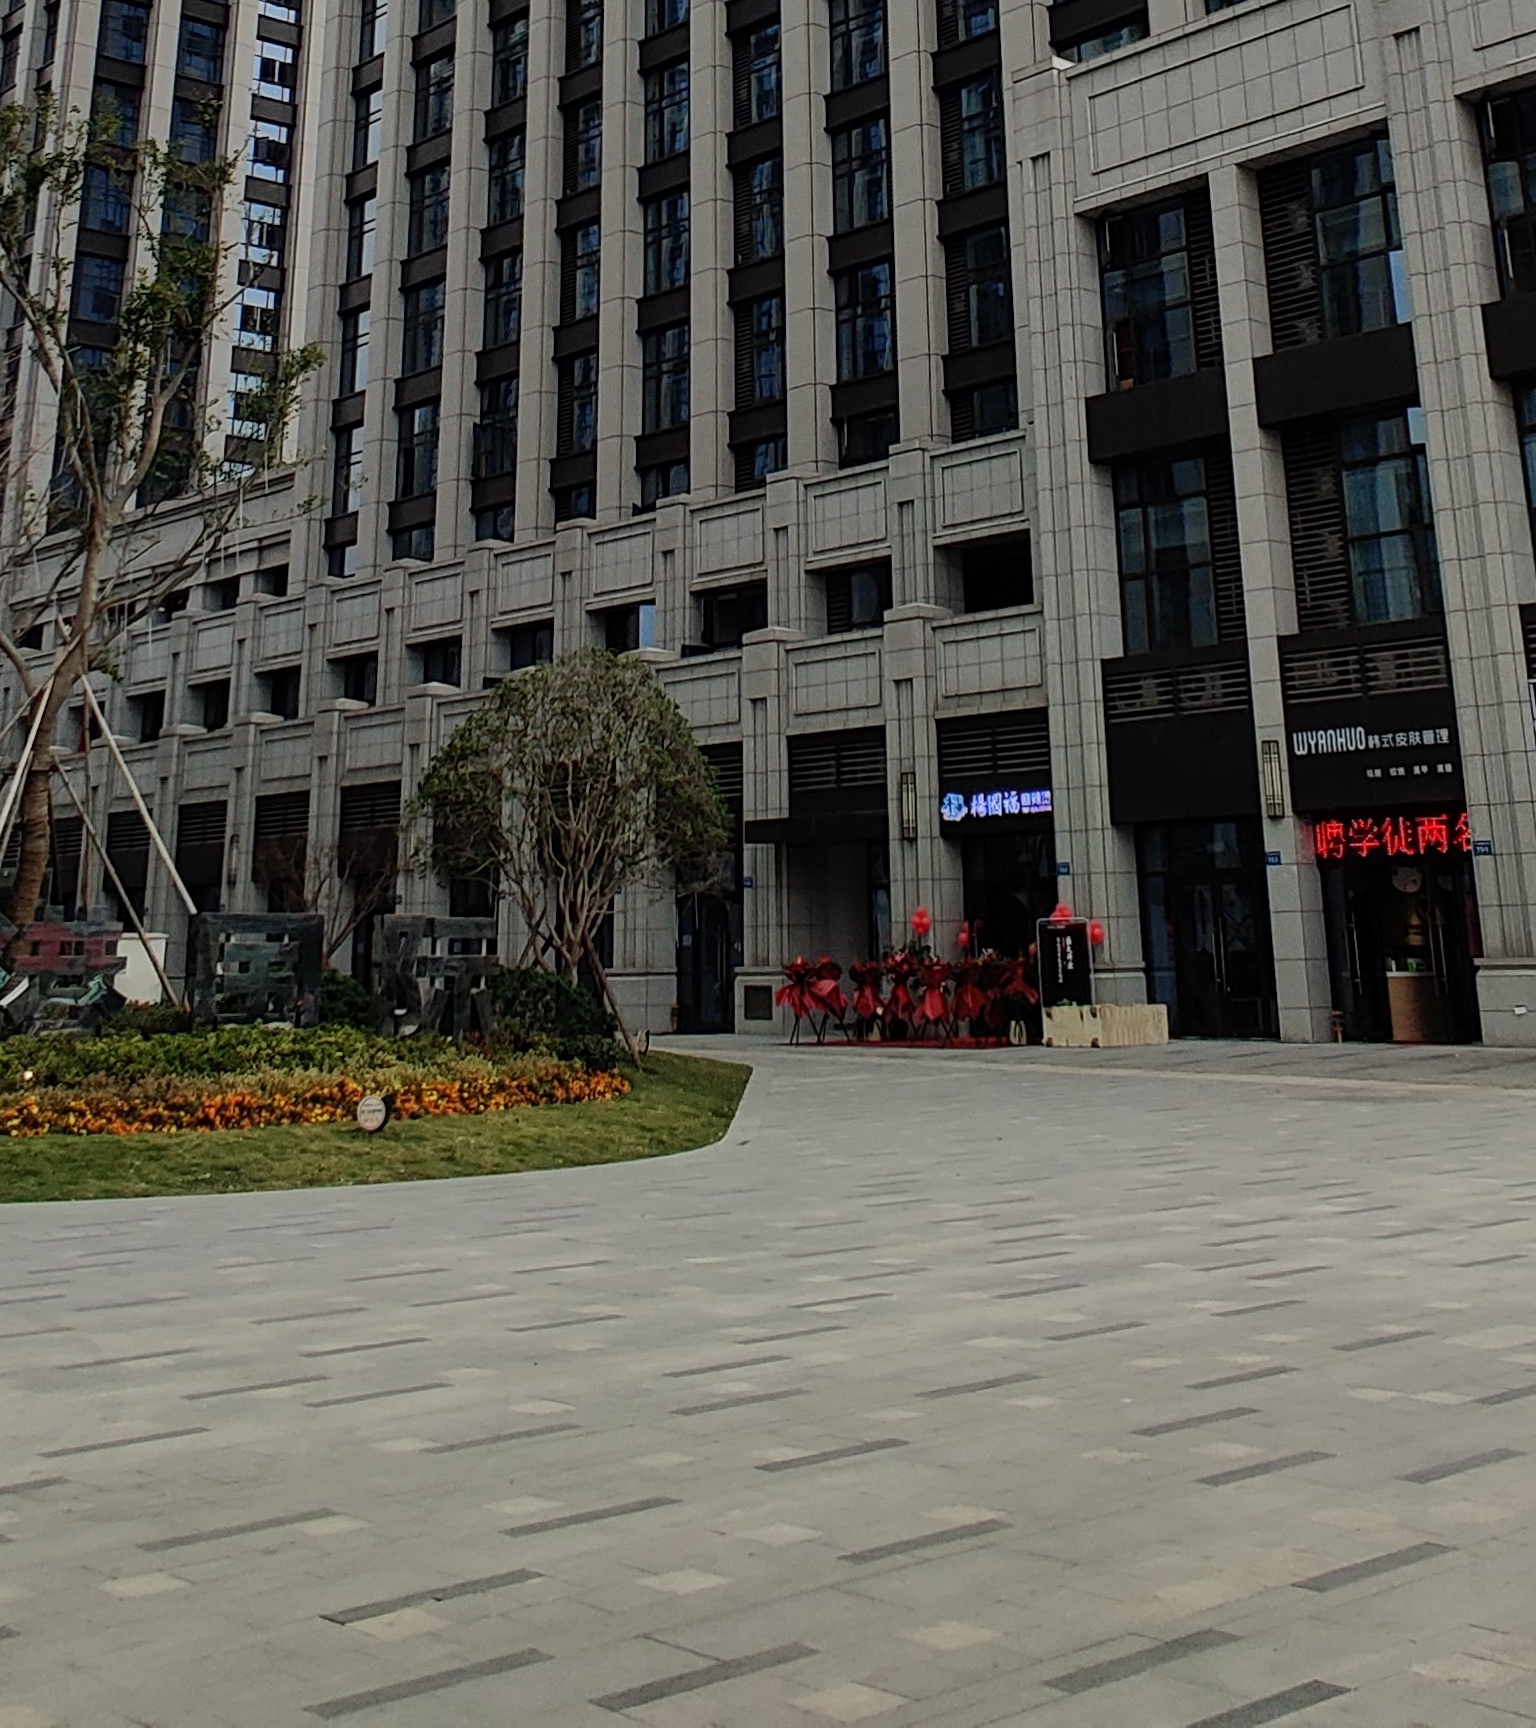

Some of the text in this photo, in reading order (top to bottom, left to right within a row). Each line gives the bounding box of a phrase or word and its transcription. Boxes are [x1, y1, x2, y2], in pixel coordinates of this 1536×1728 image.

[1292, 726, 1450, 756] WYANHUO 韩式皮肤管理
